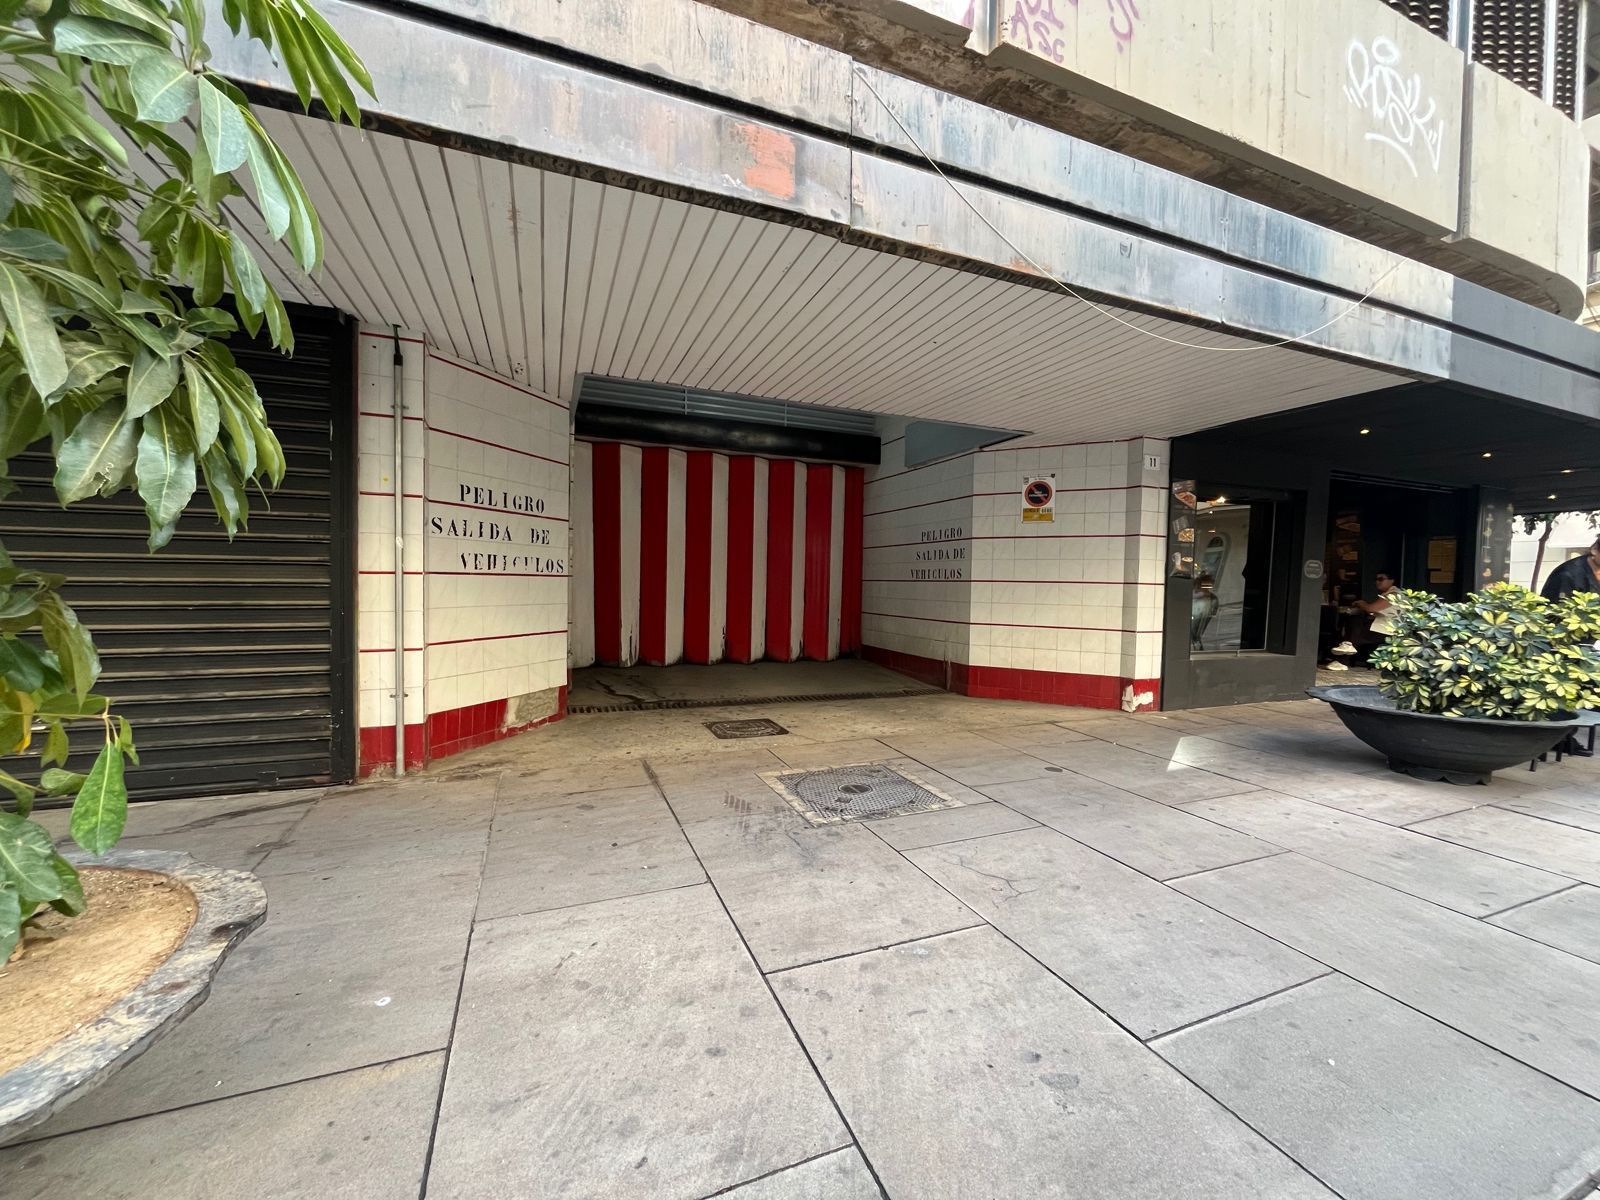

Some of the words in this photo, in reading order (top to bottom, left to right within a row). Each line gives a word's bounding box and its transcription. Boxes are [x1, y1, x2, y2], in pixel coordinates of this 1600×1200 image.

[1149, 457, 1157, 467] 11
[459, 483, 545, 514] PELIGRO
[431, 516, 513, 542] SALIDA
[530, 527, 550, 545] DE
[921, 526, 963, 542] PELIGRO
[915, 548, 950, 561] SALIDA
[953, 547, 966, 560] DE
[910, 567, 962, 580] VEHICULOS
